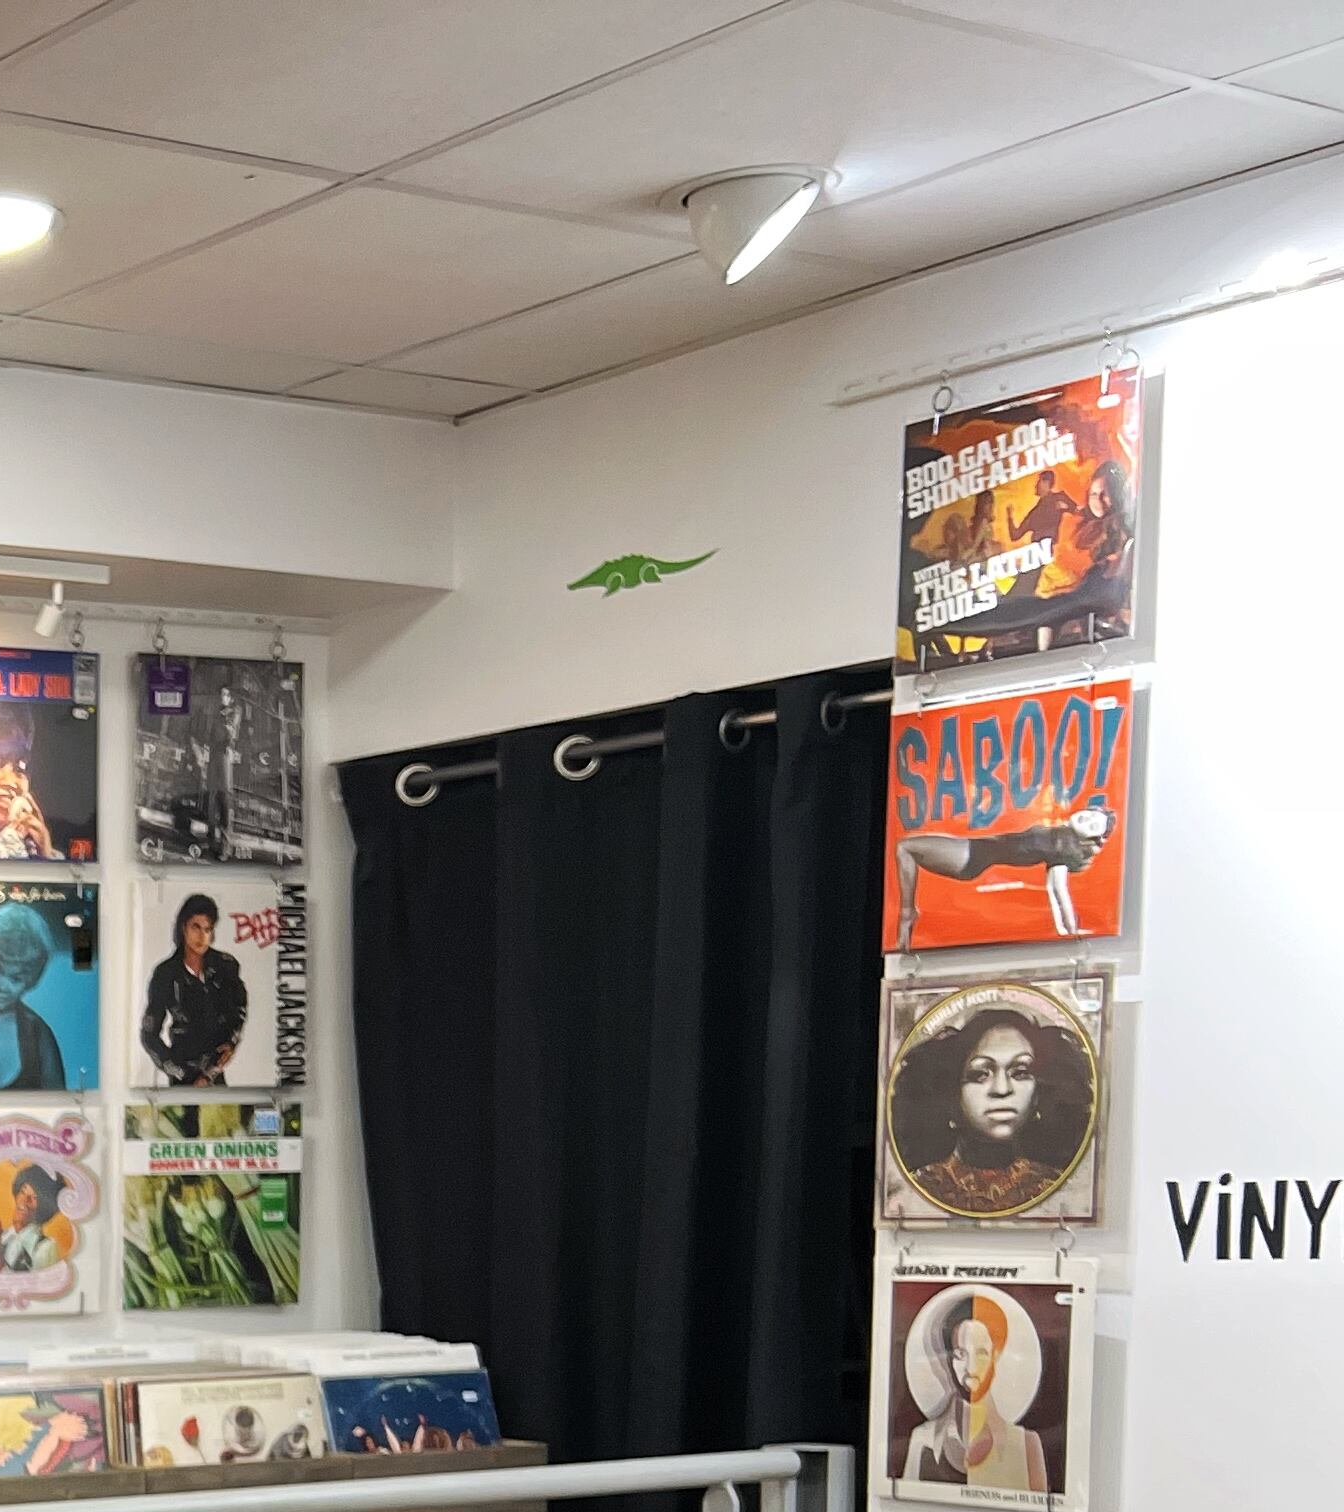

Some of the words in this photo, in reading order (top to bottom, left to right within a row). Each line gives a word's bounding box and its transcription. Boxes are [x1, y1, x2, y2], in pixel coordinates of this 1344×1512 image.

[907, 432, 1076, 519] SHING-A-LING
[913, 560, 951, 582] WITH
[914, 567, 969, 606] THE
[969, 537, 1055, 588] LATIN
[914, 583, 998, 632] SOULS
[896, 695, 1126, 832] SABOO!
[278, 883, 307, 975] MICHAEL
[276, 977, 307, 1086] JACKSON
[149, 1142, 207, 1158] GREEN
[213, 1141, 279, 1158] ONIONS
